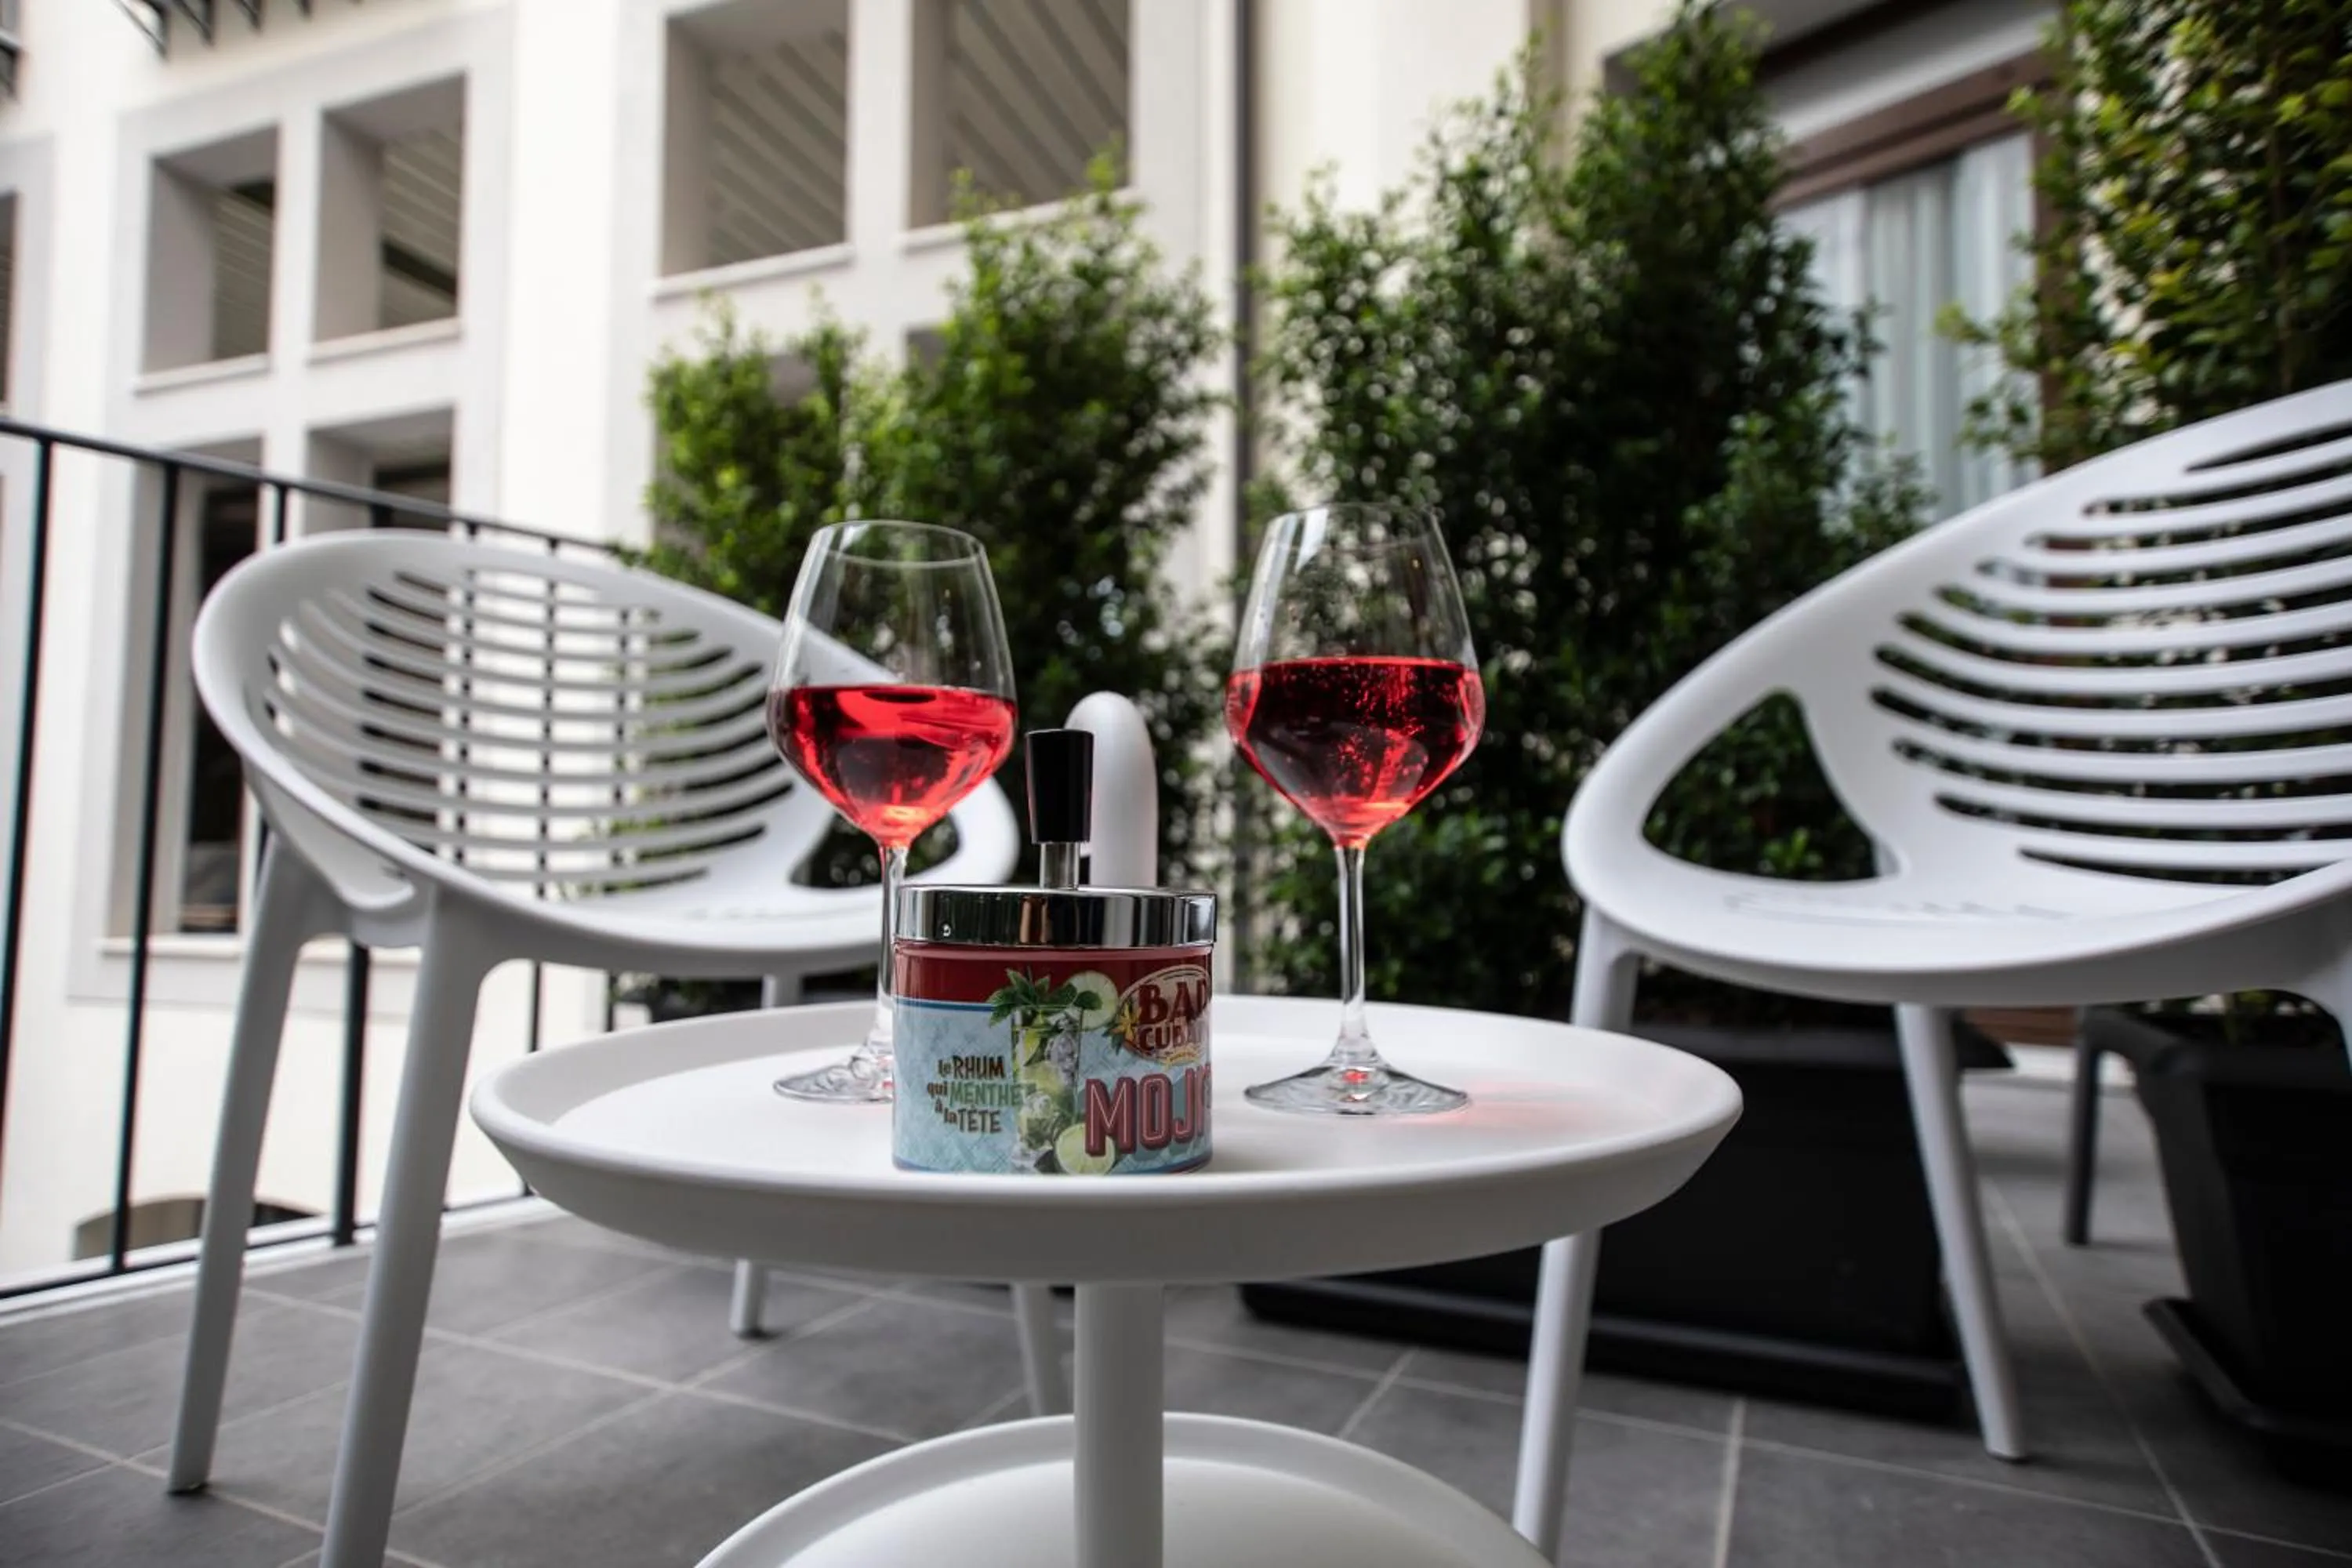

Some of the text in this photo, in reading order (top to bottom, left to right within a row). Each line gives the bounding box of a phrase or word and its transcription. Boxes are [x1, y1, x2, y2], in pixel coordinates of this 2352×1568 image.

[952, 1054, 1005, 1079] RHUM
[927, 1080, 1024, 1108] qui MENTHE
[943, 1107, 957, 1124] la
